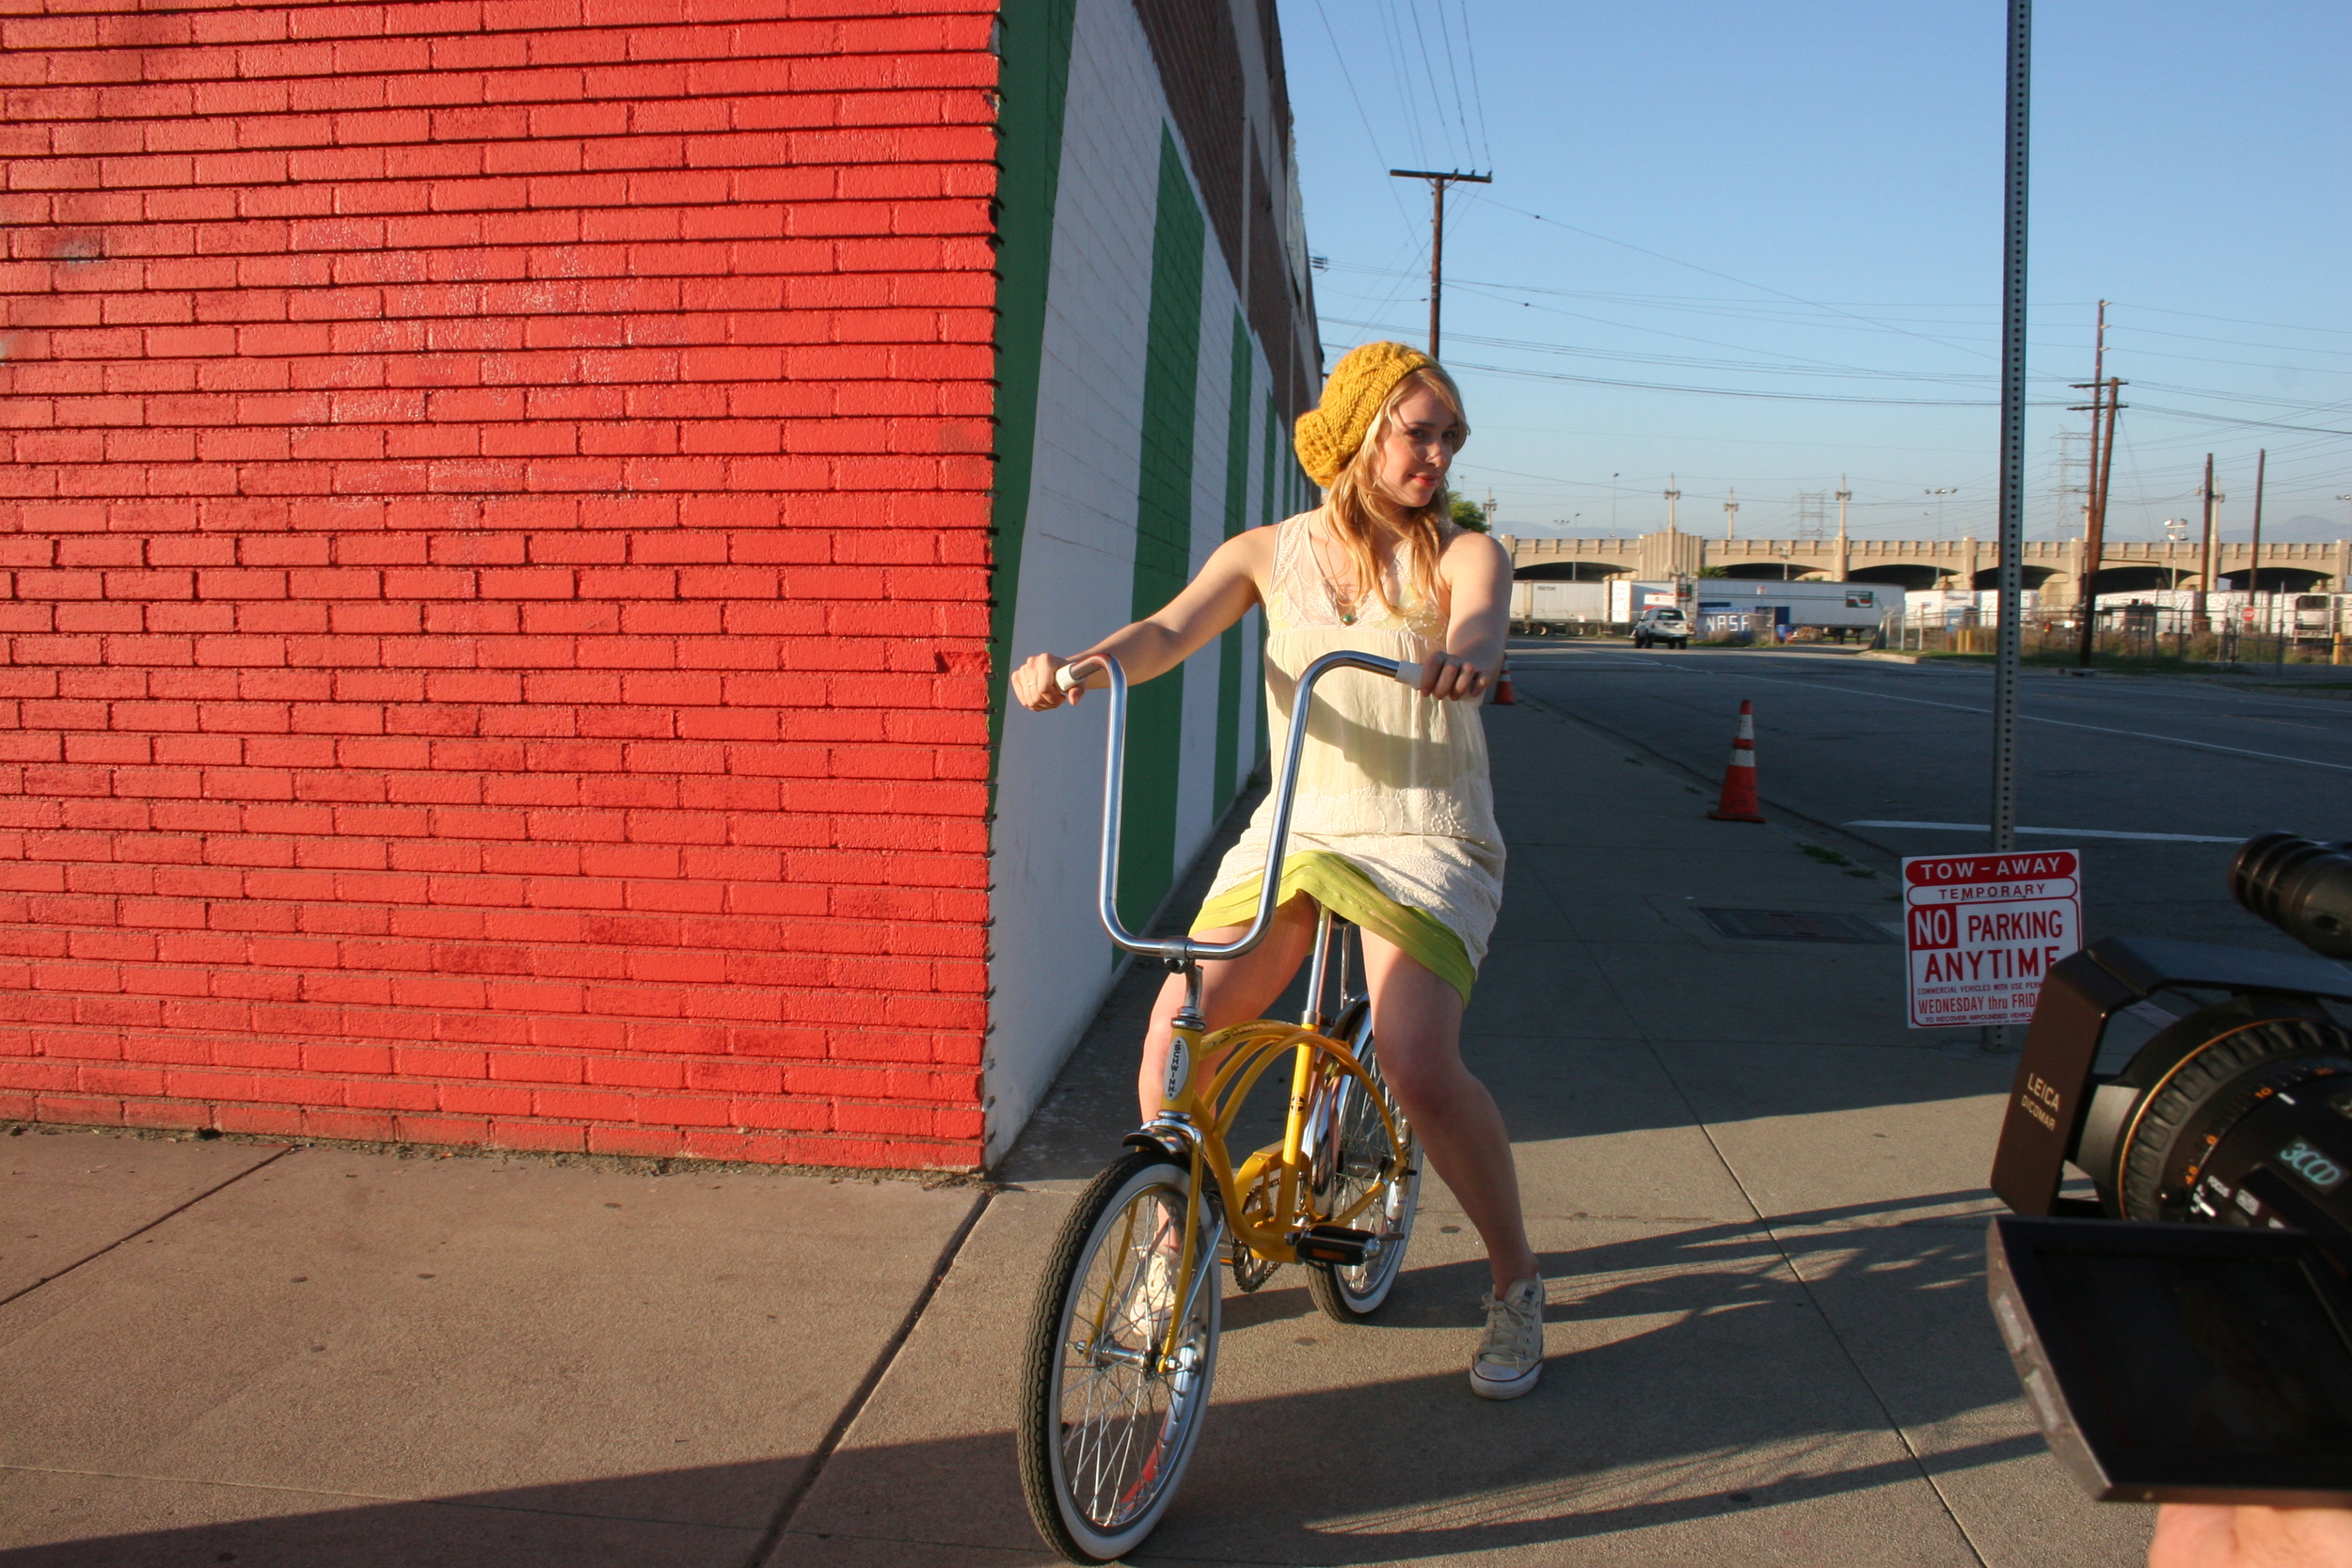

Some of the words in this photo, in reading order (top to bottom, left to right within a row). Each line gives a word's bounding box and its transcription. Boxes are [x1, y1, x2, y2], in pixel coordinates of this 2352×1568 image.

[1939, 883, 2045, 899] TEMPORARY
[1915, 909, 1951, 945] NO
[1968, 910, 2063, 942] PARKING
[1917, 986, 1958, 995] COMMERCIAL
[1960, 984, 1991, 992] VEHICLES
[1918, 996, 1984, 1014] WEDNESDAY
[1989, 995, 2008, 1010] thru
[2011, 992, 2038, 1008] FRID
[1168, 1044, 1182, 1093] SCHWINN
[2027, 1072, 2060, 1112] LEICA
[2021, 1094, 2056, 1131] DICOMAR
